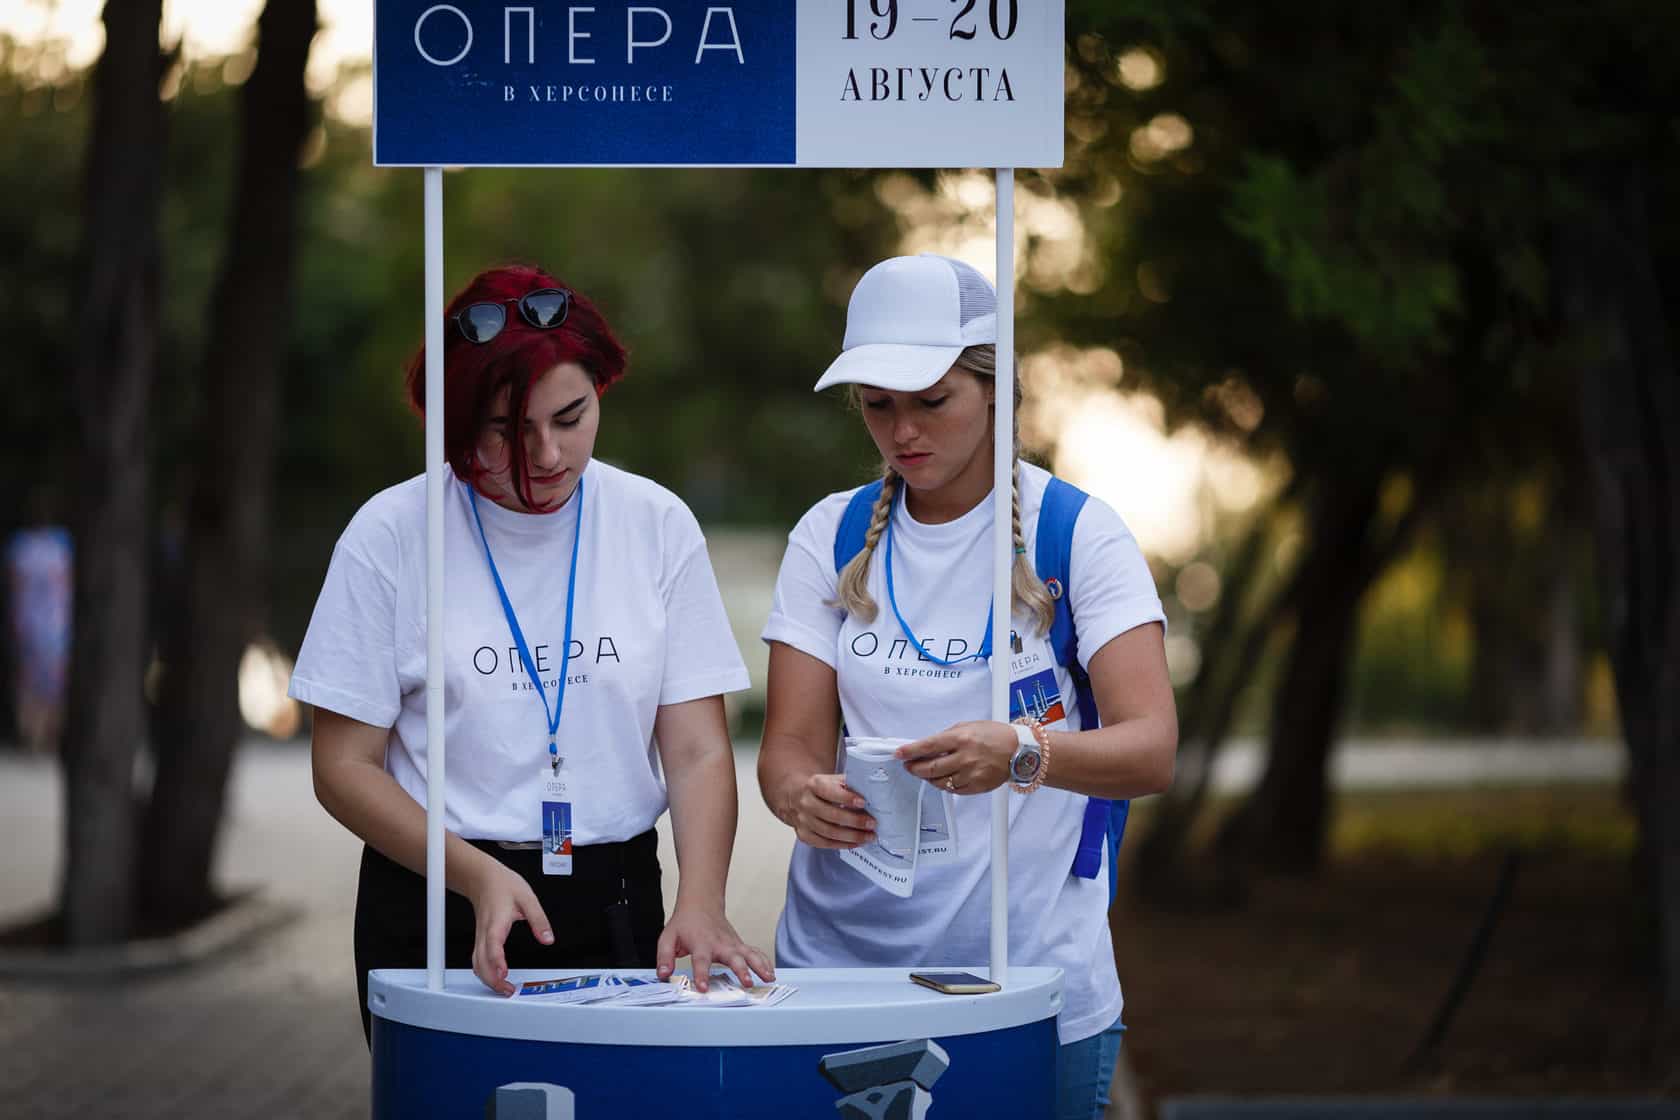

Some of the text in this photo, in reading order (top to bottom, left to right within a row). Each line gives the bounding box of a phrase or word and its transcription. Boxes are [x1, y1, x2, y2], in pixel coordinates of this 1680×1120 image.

[414, 4, 745, 66] ОПЕРА
[503, 85, 674, 102] В ХЕРСОНЕСЕ
[840, 66, 1017, 101] АВГУСТА
[851, 631, 984, 662] ОПЕР
